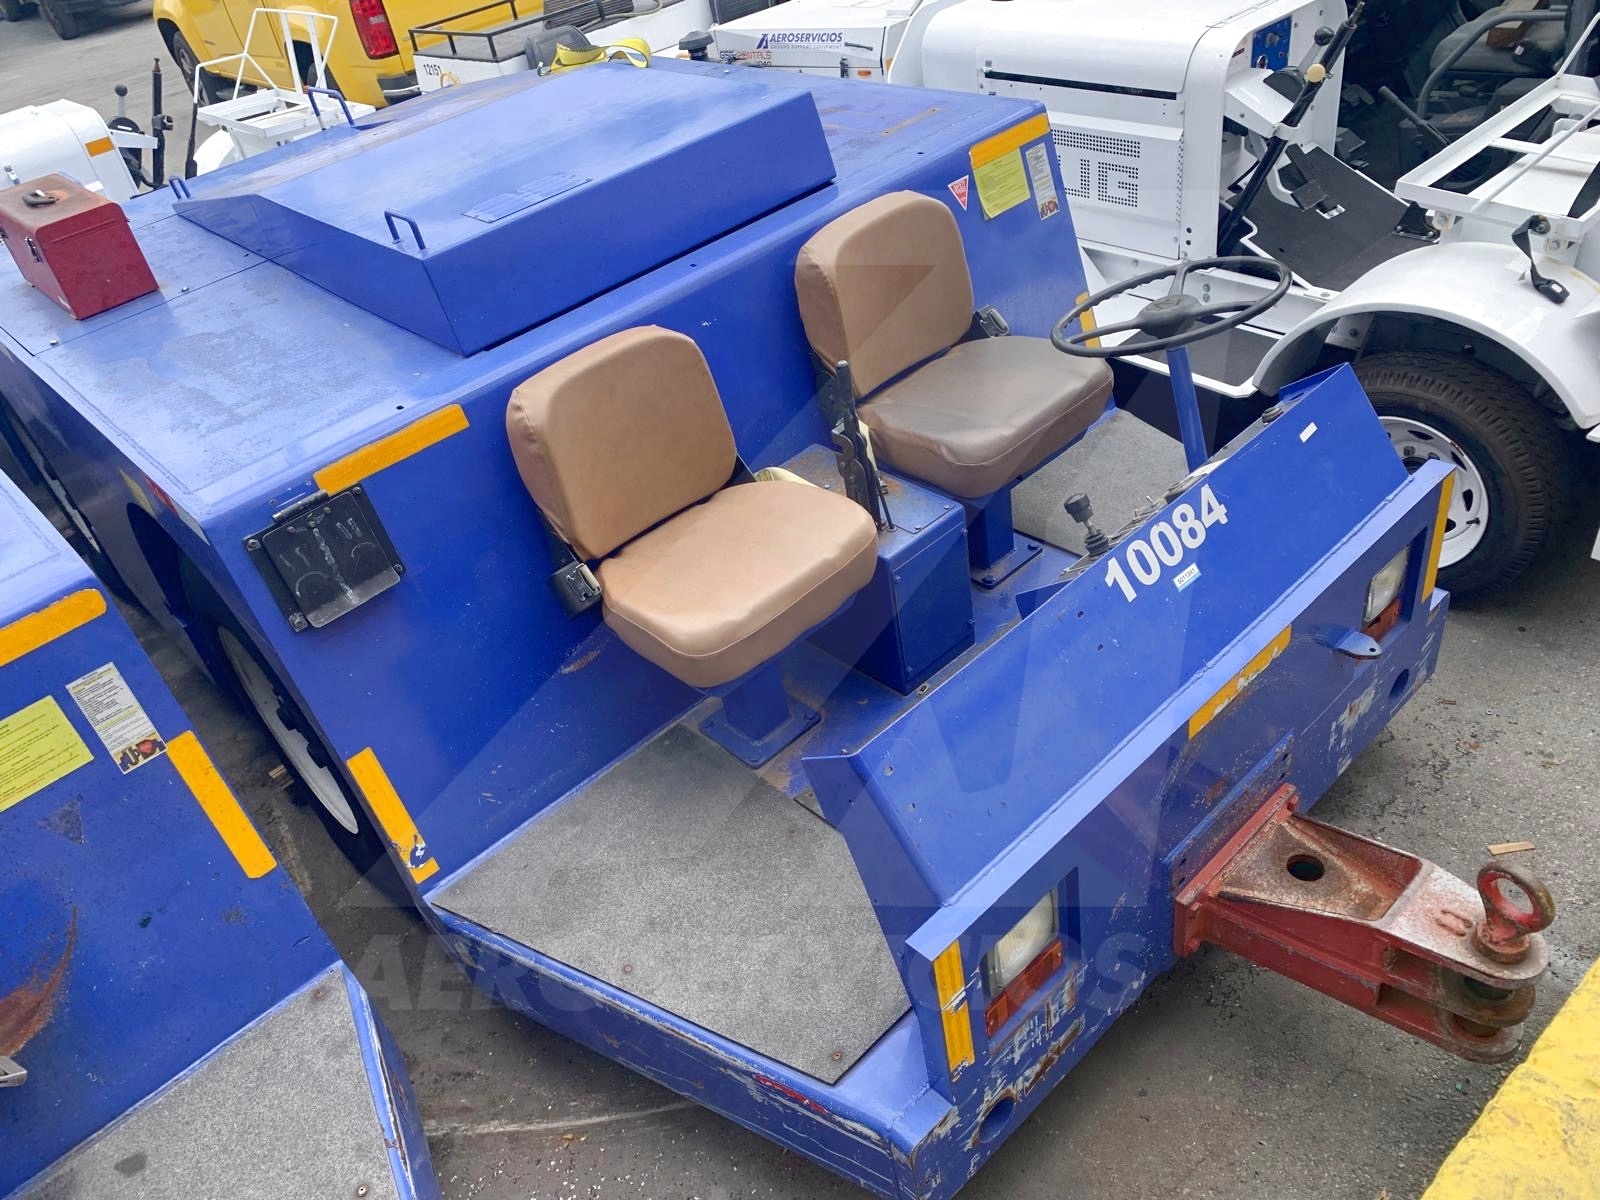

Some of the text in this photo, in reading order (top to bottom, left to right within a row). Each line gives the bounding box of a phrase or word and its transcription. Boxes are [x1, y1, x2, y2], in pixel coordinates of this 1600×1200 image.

[769, 32, 843, 43] AEROSERVICIOS
[423, 63, 443, 76] 12151
[1104, 484, 1229, 603] 10084
